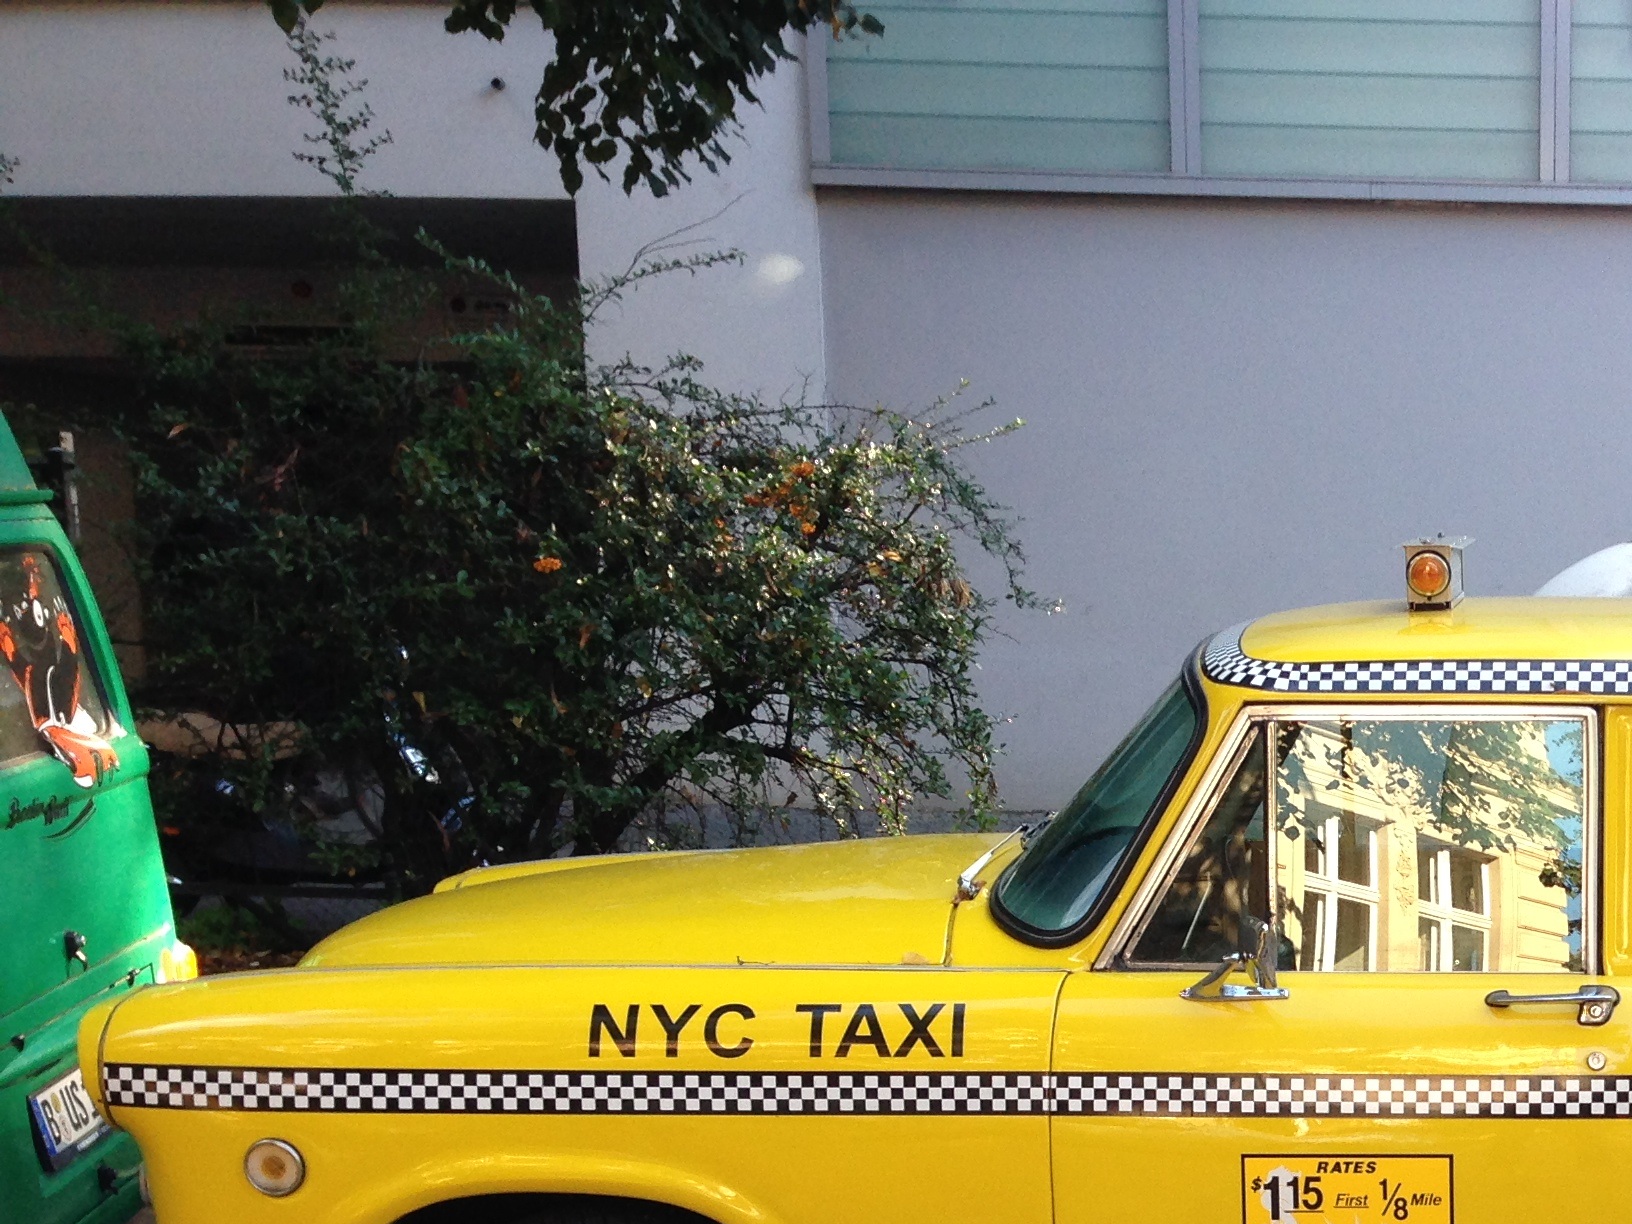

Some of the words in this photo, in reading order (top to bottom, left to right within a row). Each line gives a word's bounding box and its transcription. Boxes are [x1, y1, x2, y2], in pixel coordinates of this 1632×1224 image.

[588, 1003, 756, 1059] NYC
[795, 1003, 966, 1059] TAXI
[1316, 1161, 1377, 1174] RATES
[1335, 1193, 1369, 1207] First
[1410, 1193, 1442, 1207] Mile
